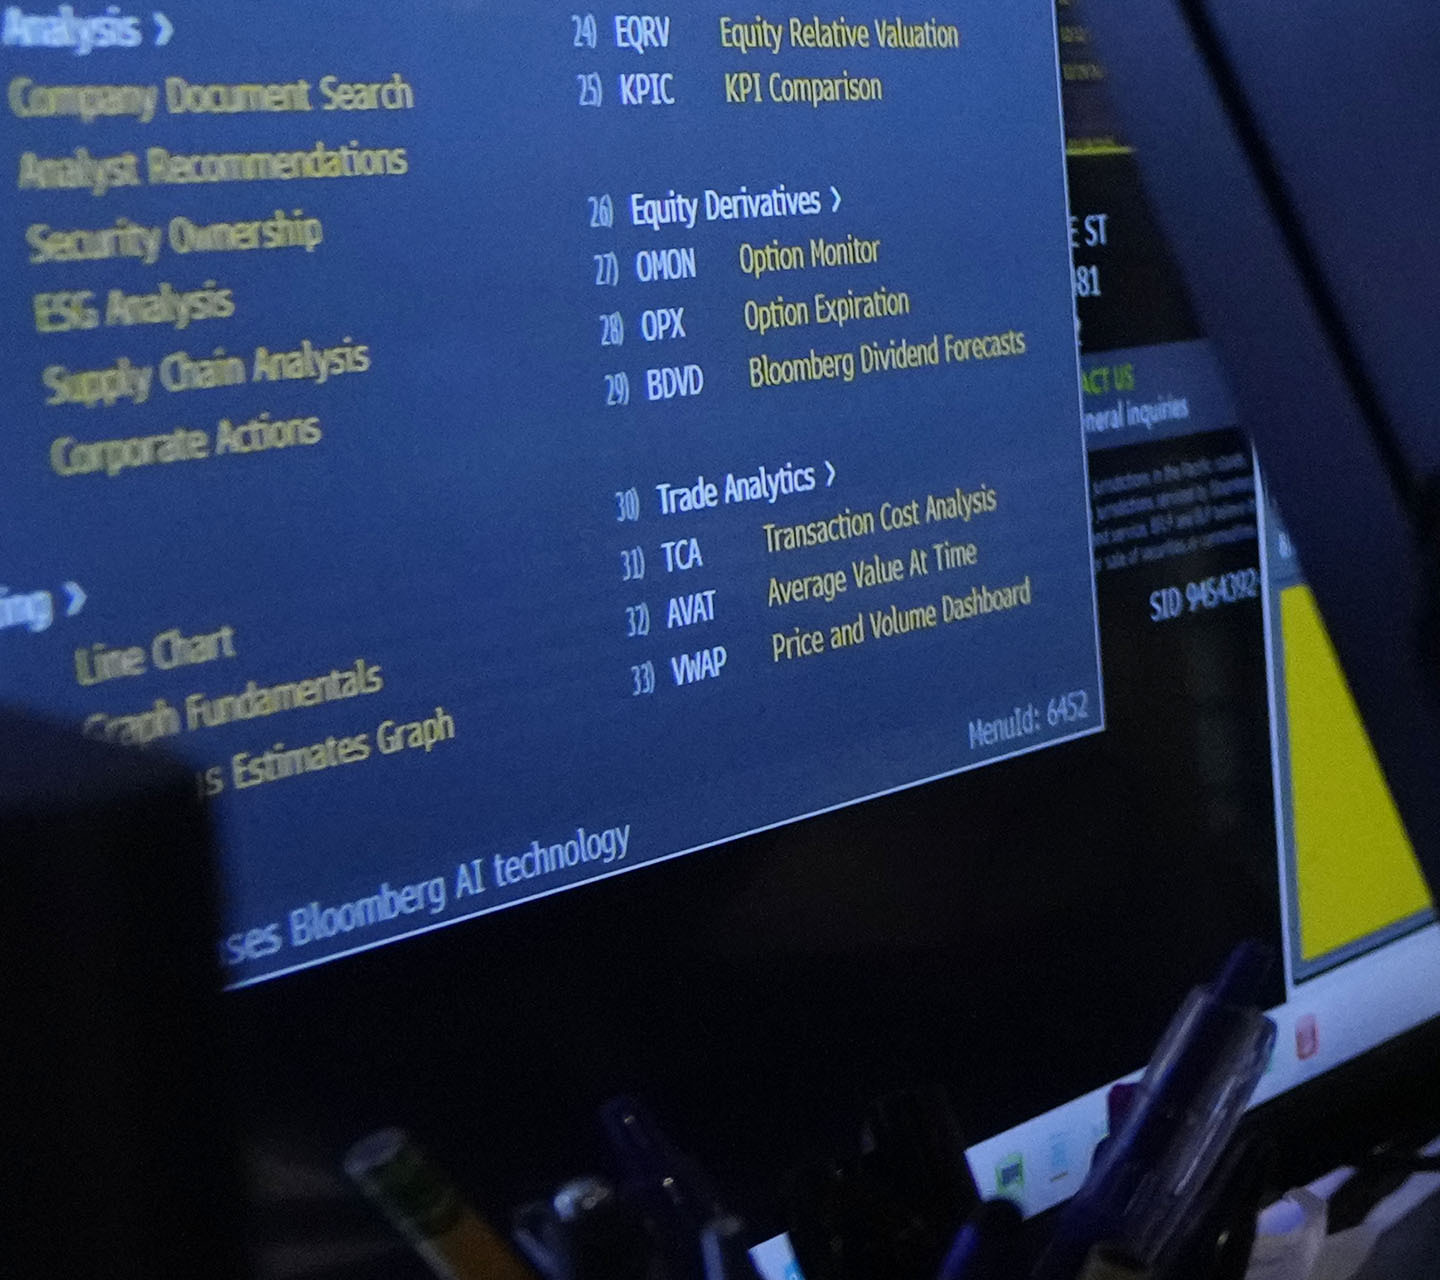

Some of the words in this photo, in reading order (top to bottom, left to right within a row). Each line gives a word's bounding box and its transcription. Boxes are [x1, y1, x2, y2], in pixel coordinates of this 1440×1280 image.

[1, 3, 143, 57] Analysis
[614, 15, 671, 55] EQRV
[719, 16, 783, 54] Equity
[789, 16, 869, 49] Relative
[874, 17, 959, 51] Valuation
[8, 76, 159, 123] Company
[164, 76, 313, 114] Document
[319, 73, 415, 111] Search
[620, 72, 675, 106] KPIC
[724, 72, 763, 104] KPI
[768, 70, 883, 106] Comparison
[18, 147, 142, 196] Analyst
[146, 140, 409, 185] Recommendations
[629, 192, 699, 232] Equity
[704, 184, 821, 223] Derivatives
[1084, 212, 1110, 248] ST
[25, 217, 162, 266] Security
[168, 209, 324, 253] Ownership
[636, 247, 697, 283] OMON
[739, 240, 805, 279] Option
[810, 233, 880, 269] Monitor
[32, 289, 99, 334] ESG
[105, 279, 236, 331] Analysis
[640, 306, 686, 343] OPX
[743, 298, 809, 338] Option
[814, 288, 910, 331] Expiration
[42, 356, 153, 406] Supply
[159, 346, 247, 393] Chain
[252, 335, 371, 385] Analysis
[646, 363, 704, 403] BDVD
[748, 348, 856, 390] Bloomberg
[859, 335, 939, 376] Dividend
[944, 326, 1027, 366] Forecasts
[49, 428, 209, 477] Corporate
[214, 410, 324, 456] Actions
[656, 475, 719, 516] Trade
[723, 461, 817, 509] Analytics
[661, 536, 704, 573] TCA
[762, 502, 875, 555] Transaction
[879, 496, 921, 531] Cost
[924, 482, 998, 522] Analysis
[666, 589, 717, 630] AVAT
[767, 568, 848, 609] Average
[851, 554, 905, 590] Value
[908, 548, 929, 578] At
[932, 538, 979, 573] Time
[1149, 586, 1184, 623] SID
[74, 640, 146, 687] Line
[151, 624, 236, 672] Chart
[671, 645, 728, 687] VWAP
[771, 629, 824, 664] Price
[829, 614, 866, 651] and
[868, 599, 938, 640] Volume
[940, 574, 1033, 624] Dashboard
[185, 657, 384, 731] Fundamentals
[1046, 687, 1089, 725] 6452
[231, 731, 371, 791] Estimates
[375, 706, 456, 756] Graph
[289, 871, 449, 949] Bloomberg
[455, 856, 489, 901] AI
[493, 822, 632, 890] technology
